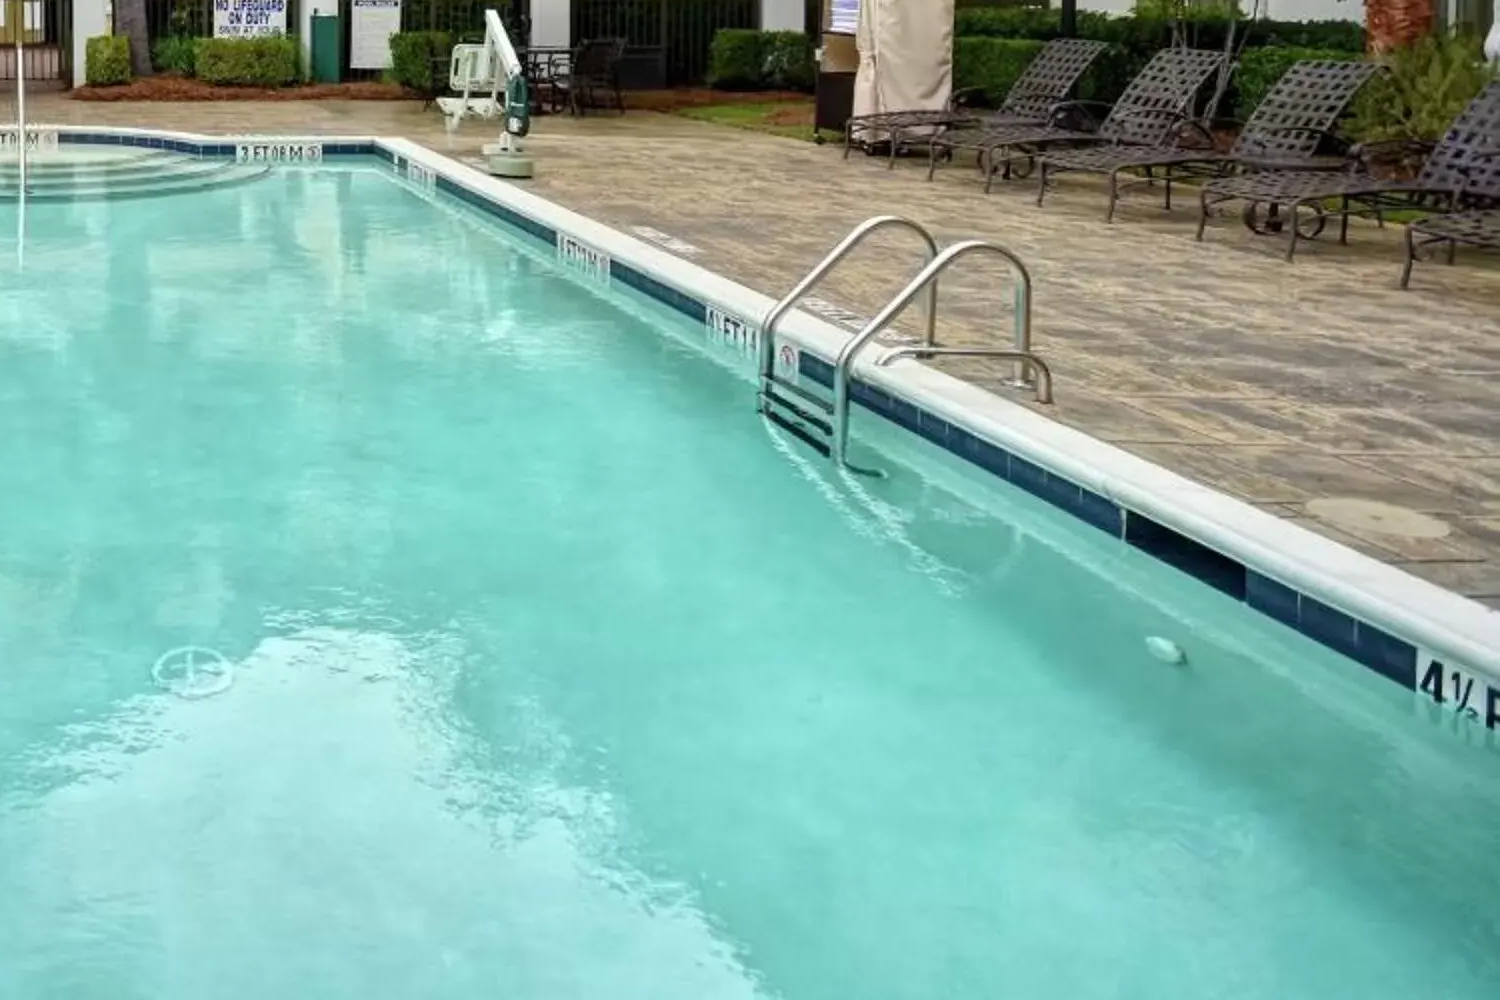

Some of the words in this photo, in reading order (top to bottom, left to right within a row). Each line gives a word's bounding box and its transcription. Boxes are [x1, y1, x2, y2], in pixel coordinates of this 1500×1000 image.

[216, 0, 228, 11] NO
[234, 0, 284, 12] LIFEGUARD
[228, 12, 242, 25] ON
[246, 12, 270, 25] DUTY
